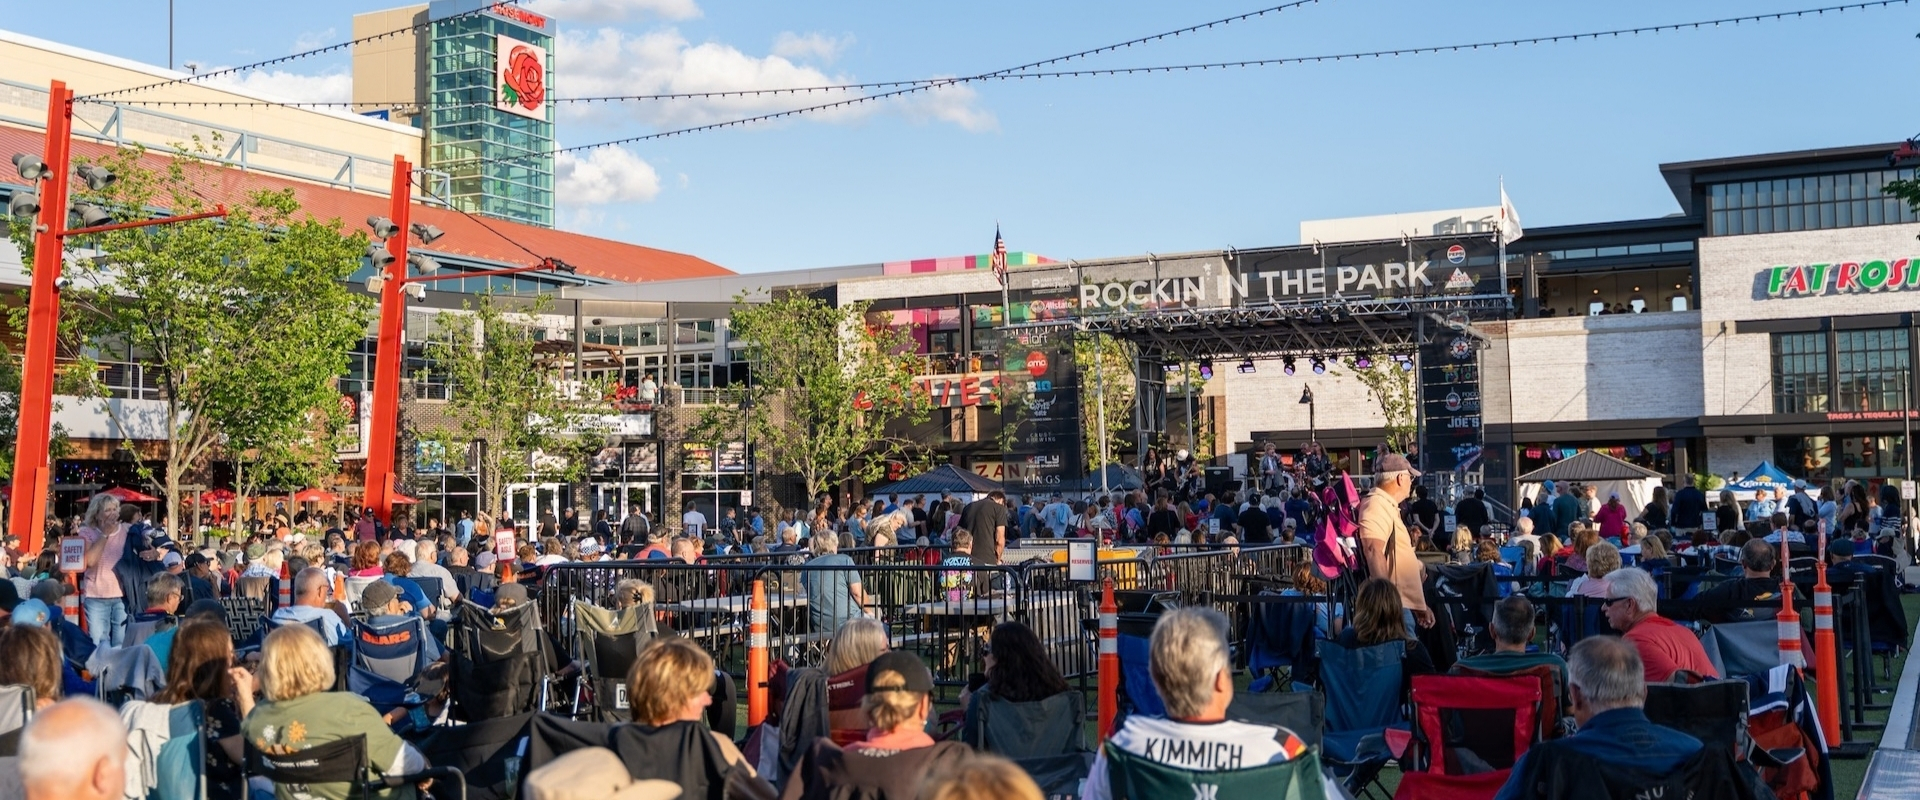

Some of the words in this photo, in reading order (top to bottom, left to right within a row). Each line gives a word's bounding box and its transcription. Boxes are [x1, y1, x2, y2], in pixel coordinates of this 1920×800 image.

[1217, 273, 1249, 300] IN
[1259, 267, 1325, 297] THE
[1336, 260, 1433, 292] PARK
[1768, 263, 1832, 294] FAT
[1020, 331, 1048, 345] aloft
[1827, 412, 1854, 420] TACOS
[1863, 411, 1899, 419] TEQUILA
[1447, 415, 1480, 428] JOE'S
[1034, 454, 1060, 465] iFLY
[1023, 474, 1061, 485] KINGS
[1738, 480, 1788, 489] Corona
[498, 537, 513, 546] SAFETY
[63, 546, 83, 554] SAFETY
[65, 554, 80, 563] AISLE
[362, 630, 411, 645] BEARS
[1144, 737, 1244, 770] KIMMICH
